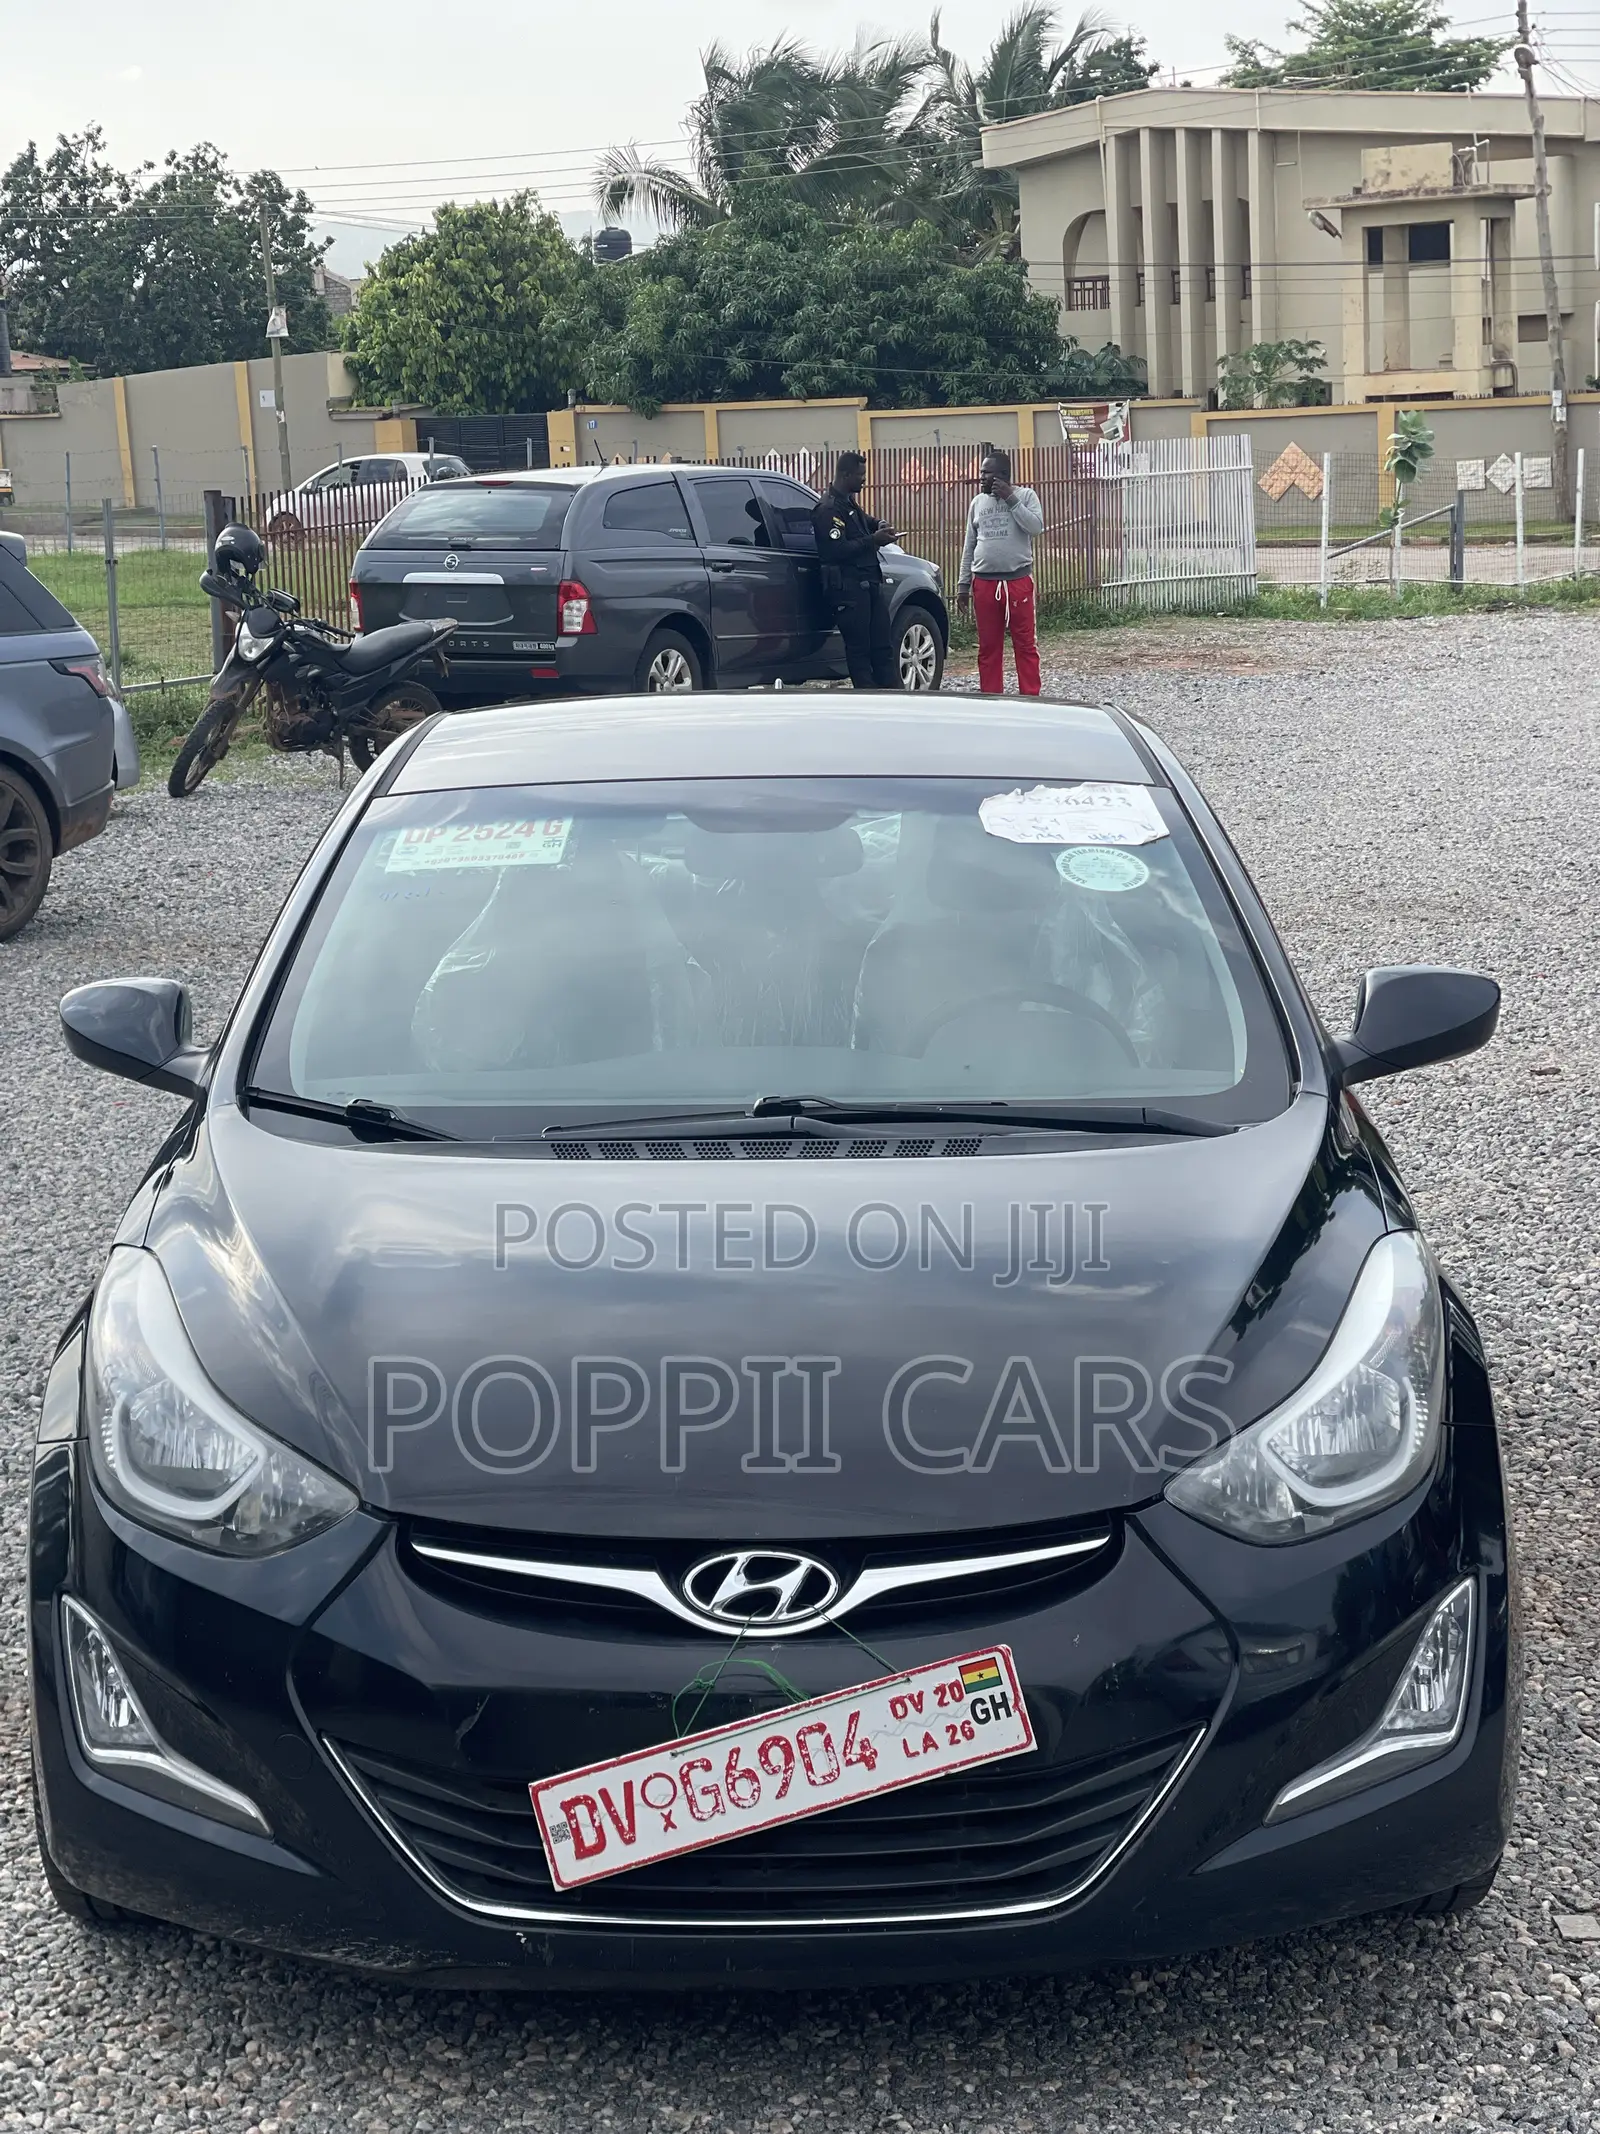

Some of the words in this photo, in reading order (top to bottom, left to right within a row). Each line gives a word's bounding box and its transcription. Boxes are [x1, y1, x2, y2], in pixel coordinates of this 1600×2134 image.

[452, 820, 536, 843] 2524
[543, 817, 564, 836] G
[888, 1690, 924, 1721] DV
[933, 1679, 964, 1708] 20
[970, 1691, 1012, 1725] GH
[902, 1731, 939, 1758] LA
[945, 1719, 975, 1746] 26
[560, 1779, 636, 1861] DV
[678, 1709, 878, 1822] G6904
